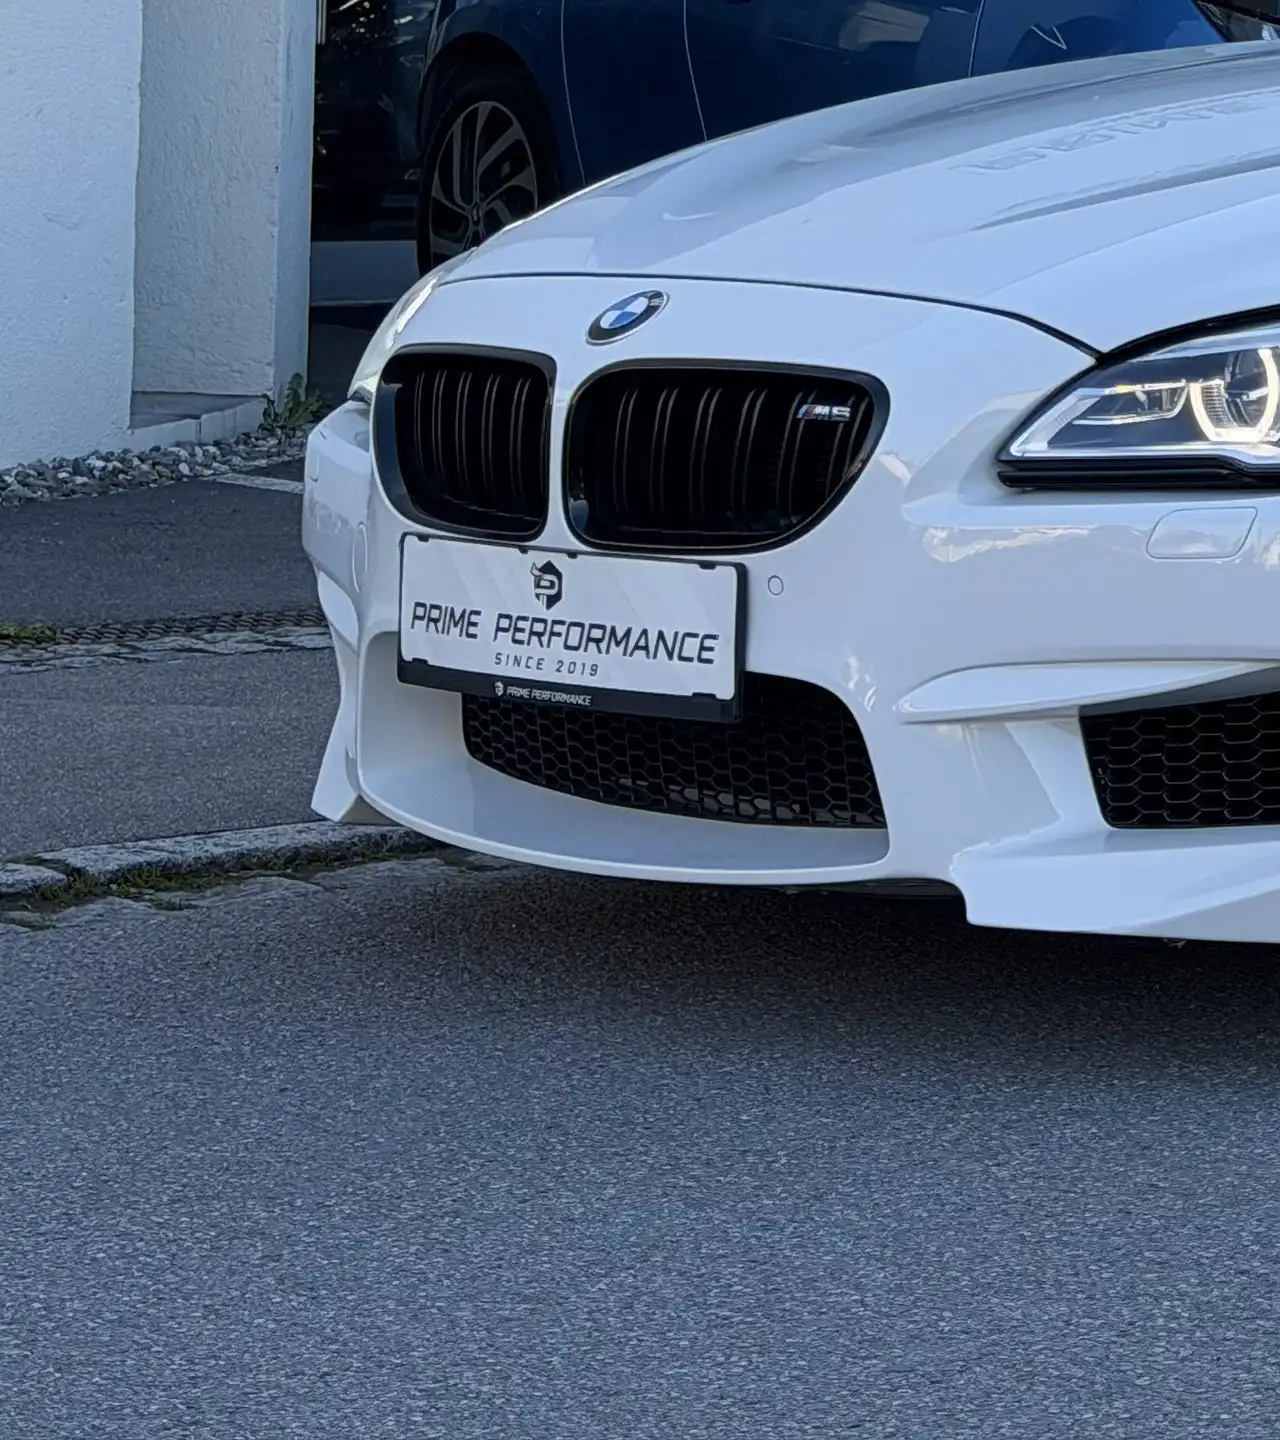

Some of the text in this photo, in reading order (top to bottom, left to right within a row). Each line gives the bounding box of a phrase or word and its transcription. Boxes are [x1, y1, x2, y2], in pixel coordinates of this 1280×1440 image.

[410, 601, 720, 665] PRIME PERFORMANCE
[494, 652, 599, 677] SINCE 2019
[507, 686, 592, 707] PRIME PERFORMANCE
